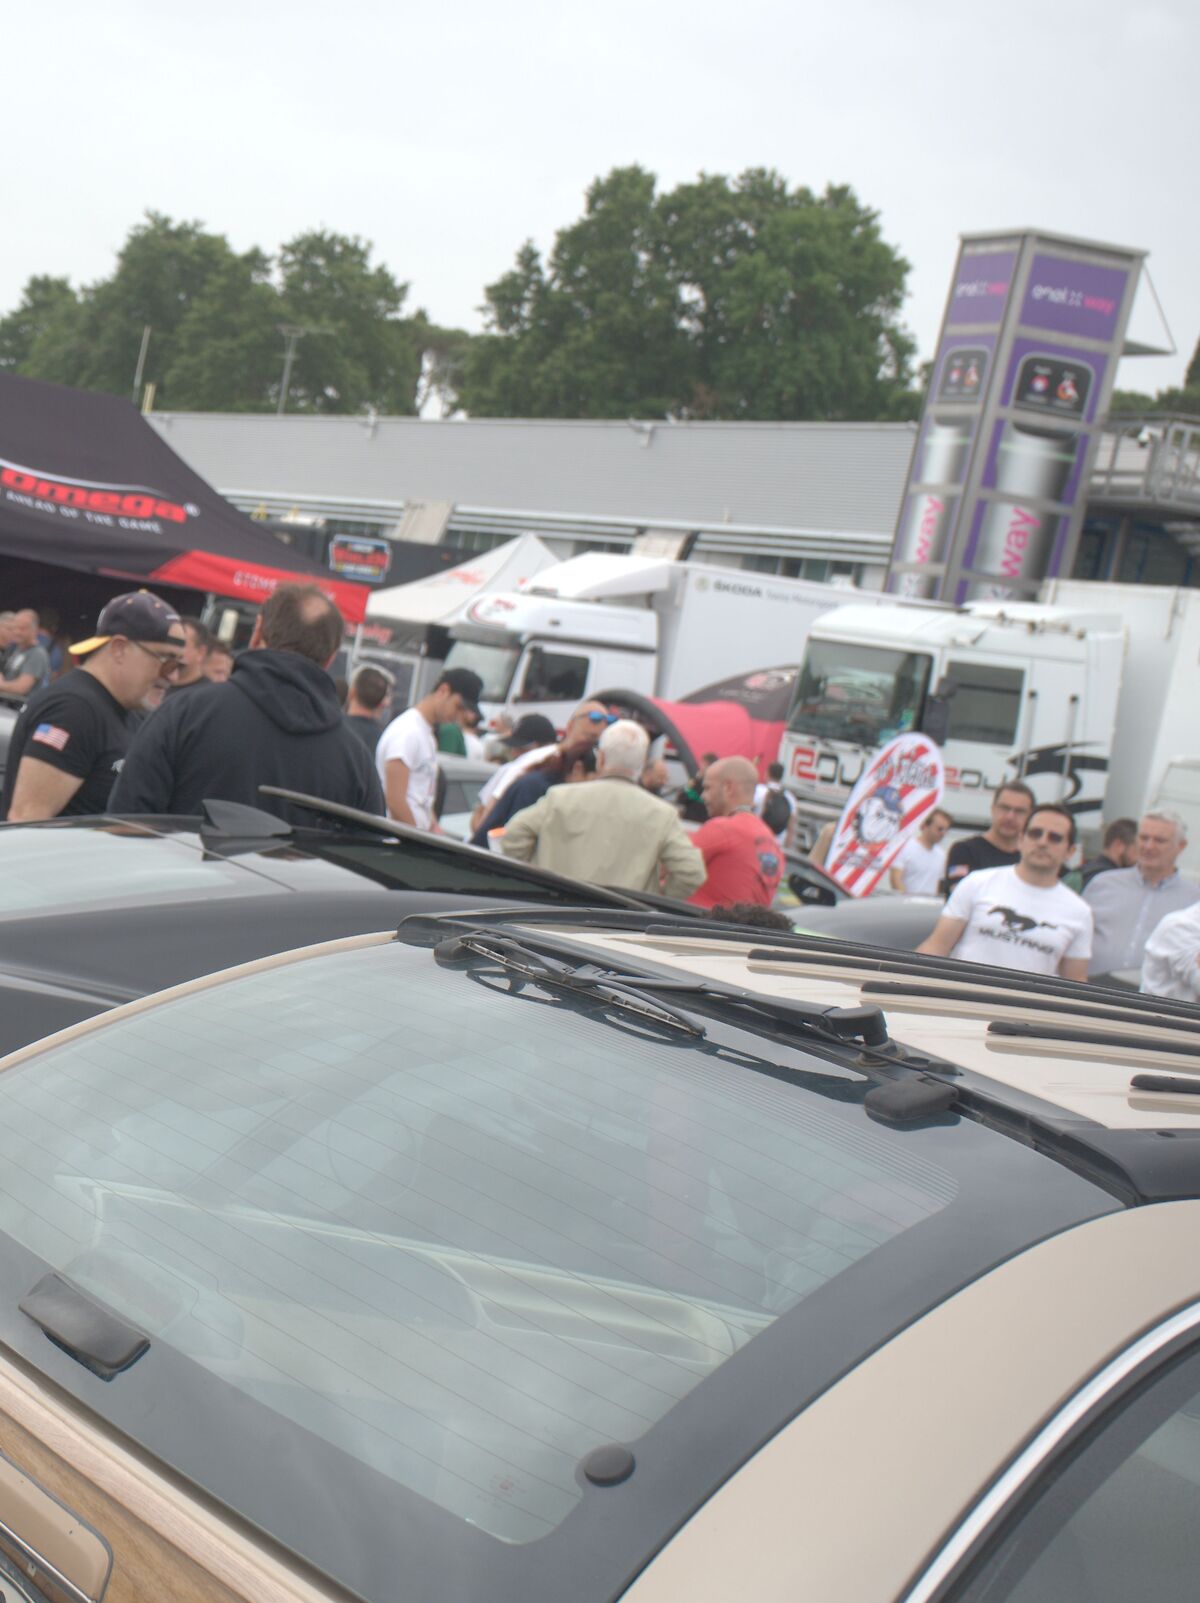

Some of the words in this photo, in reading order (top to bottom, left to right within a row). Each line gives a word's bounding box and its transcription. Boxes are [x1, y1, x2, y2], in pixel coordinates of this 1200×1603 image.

[6, 489, 56, 514] AHEAD
[60, 504, 80, 519] OF
[85, 510, 115, 528] THE
[118, 516, 163, 535] GAME
[1001, 506, 1042, 579] way
[978, 926, 1055, 955] MUSTANG
